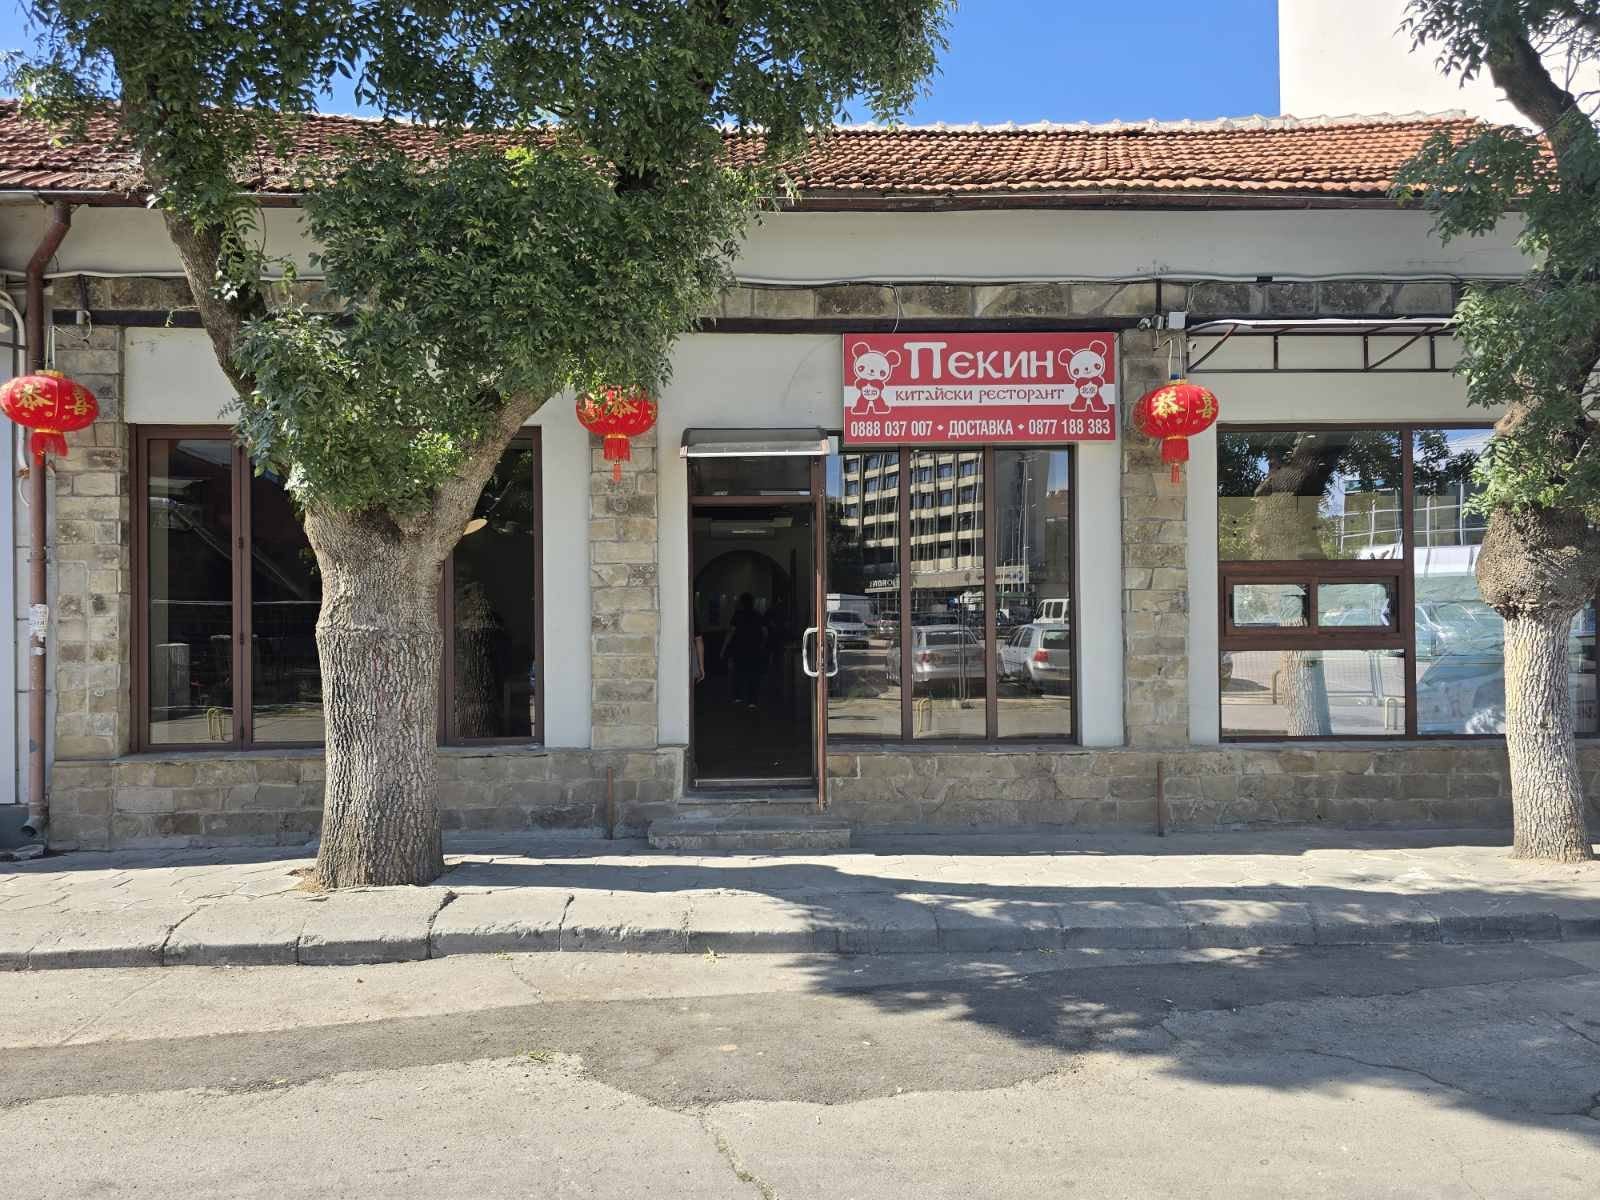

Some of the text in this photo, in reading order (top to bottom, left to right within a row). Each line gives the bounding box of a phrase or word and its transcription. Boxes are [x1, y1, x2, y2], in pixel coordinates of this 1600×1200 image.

[850, 418, 1111, 439] 0888 037 007 ДОСТАВКА 0877 188 383
